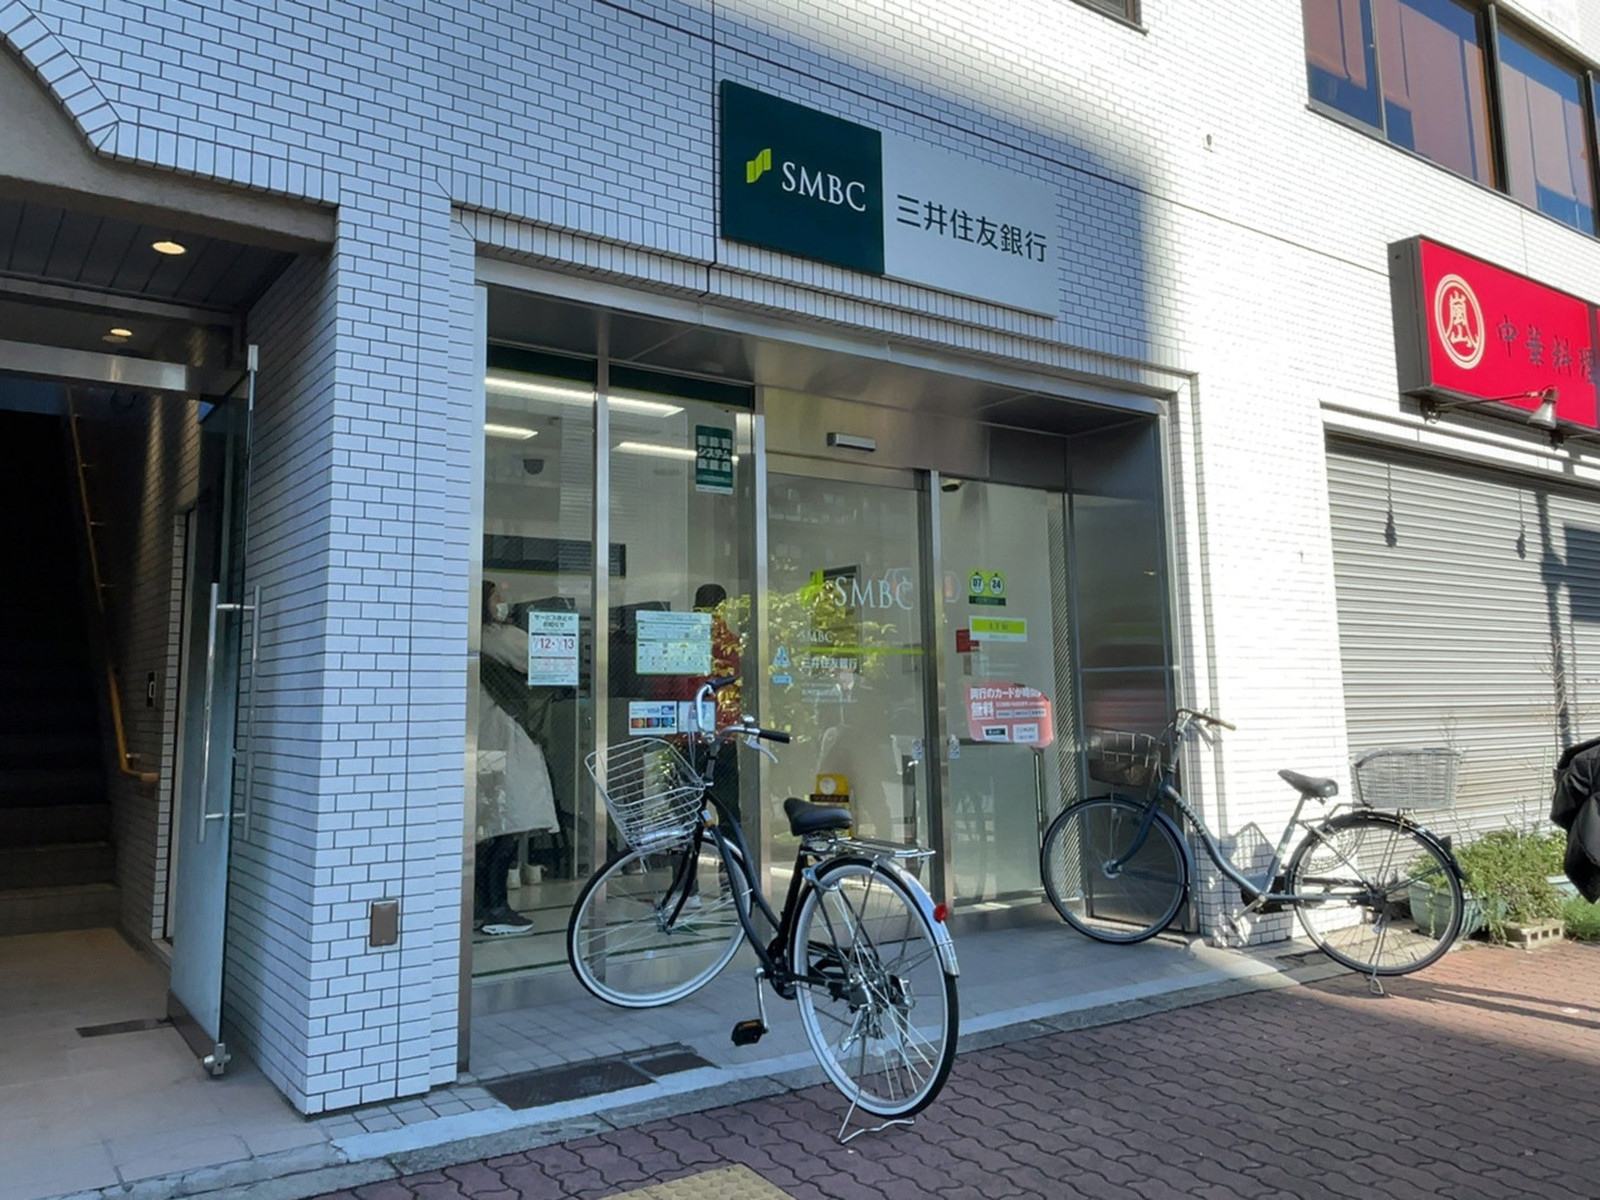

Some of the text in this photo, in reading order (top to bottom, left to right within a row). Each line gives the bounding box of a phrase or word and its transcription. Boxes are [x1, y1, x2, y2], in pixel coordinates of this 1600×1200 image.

[781, 161, 866, 212] SMBC
[897, 193, 1047, 263] 三井住友銀行
[834, 576, 914, 611] SMBC
